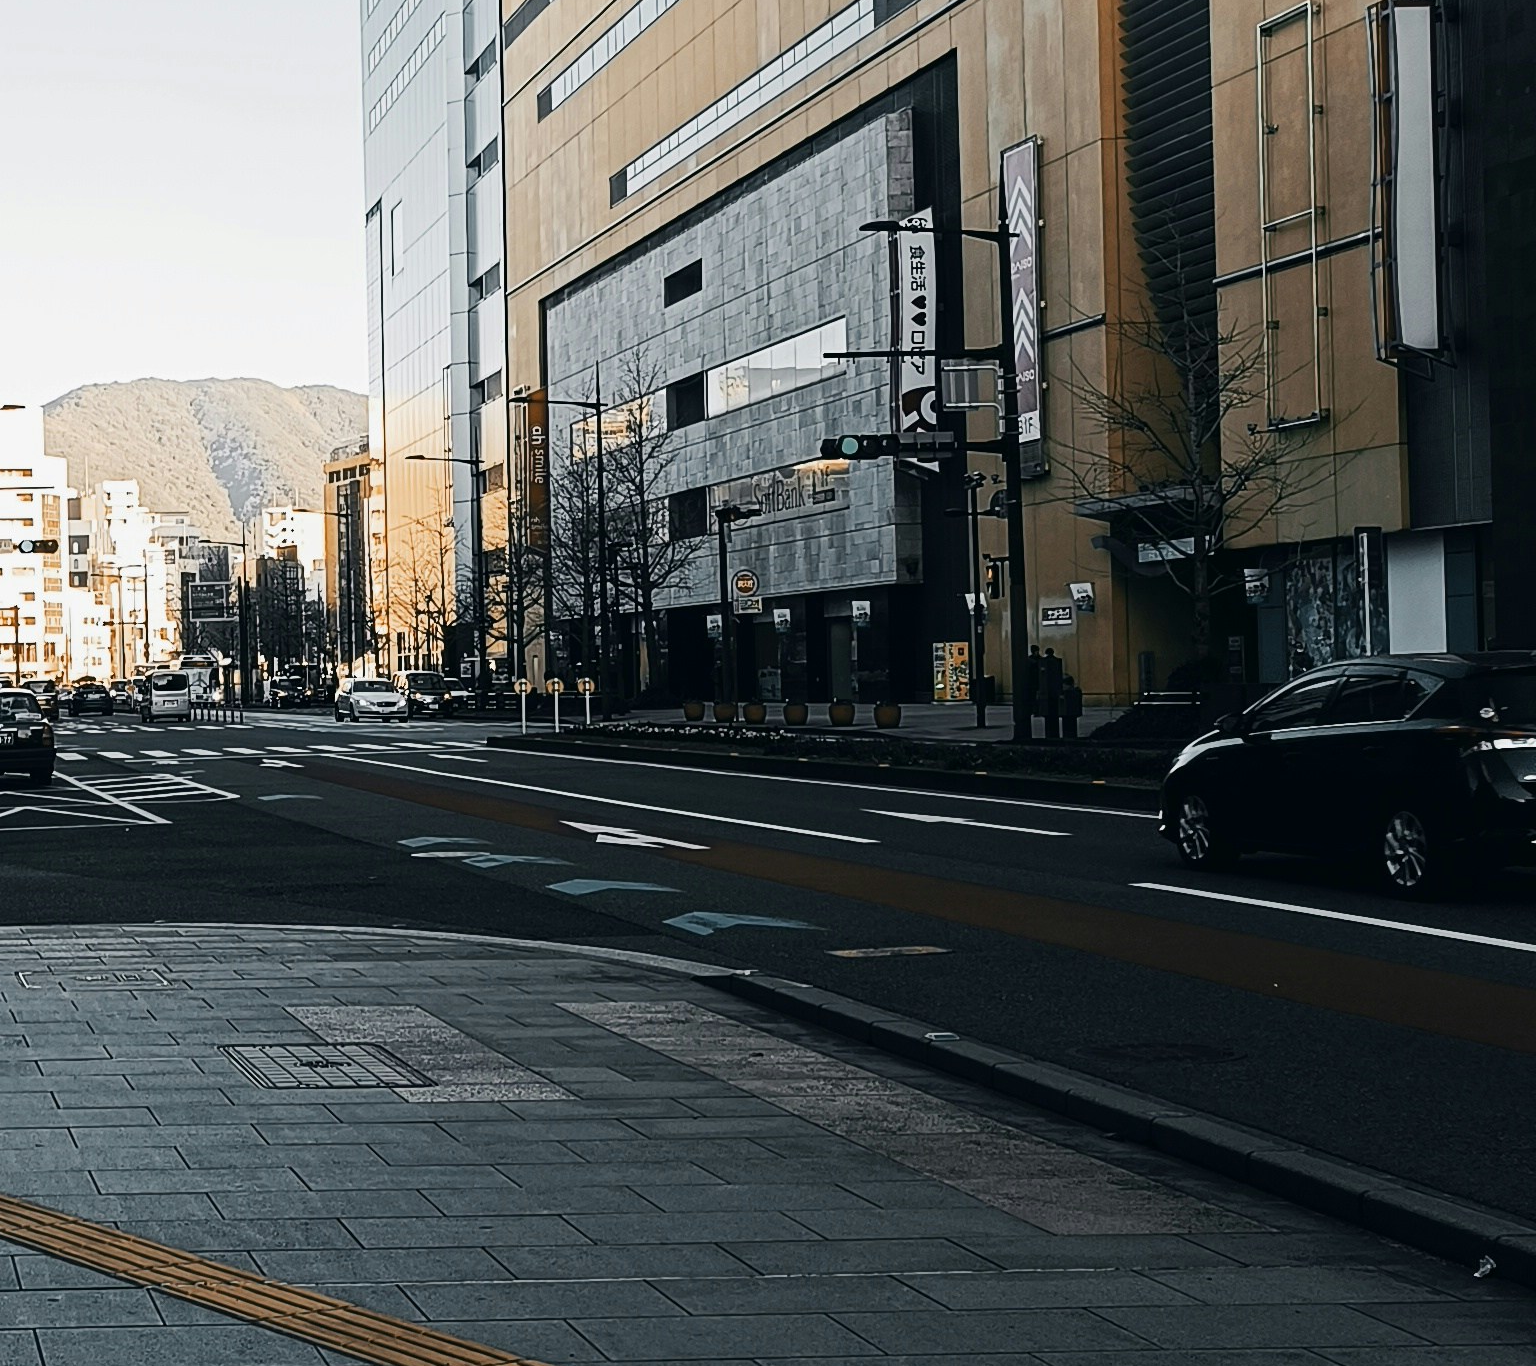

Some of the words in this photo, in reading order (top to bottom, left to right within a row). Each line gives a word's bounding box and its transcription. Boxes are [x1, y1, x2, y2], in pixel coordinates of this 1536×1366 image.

[910, 245, 926, 292] 食生活
[1016, 369, 1035, 382] AISO
[535, 449, 547, 484] smile
[754, 475, 806, 515] SoftBank
